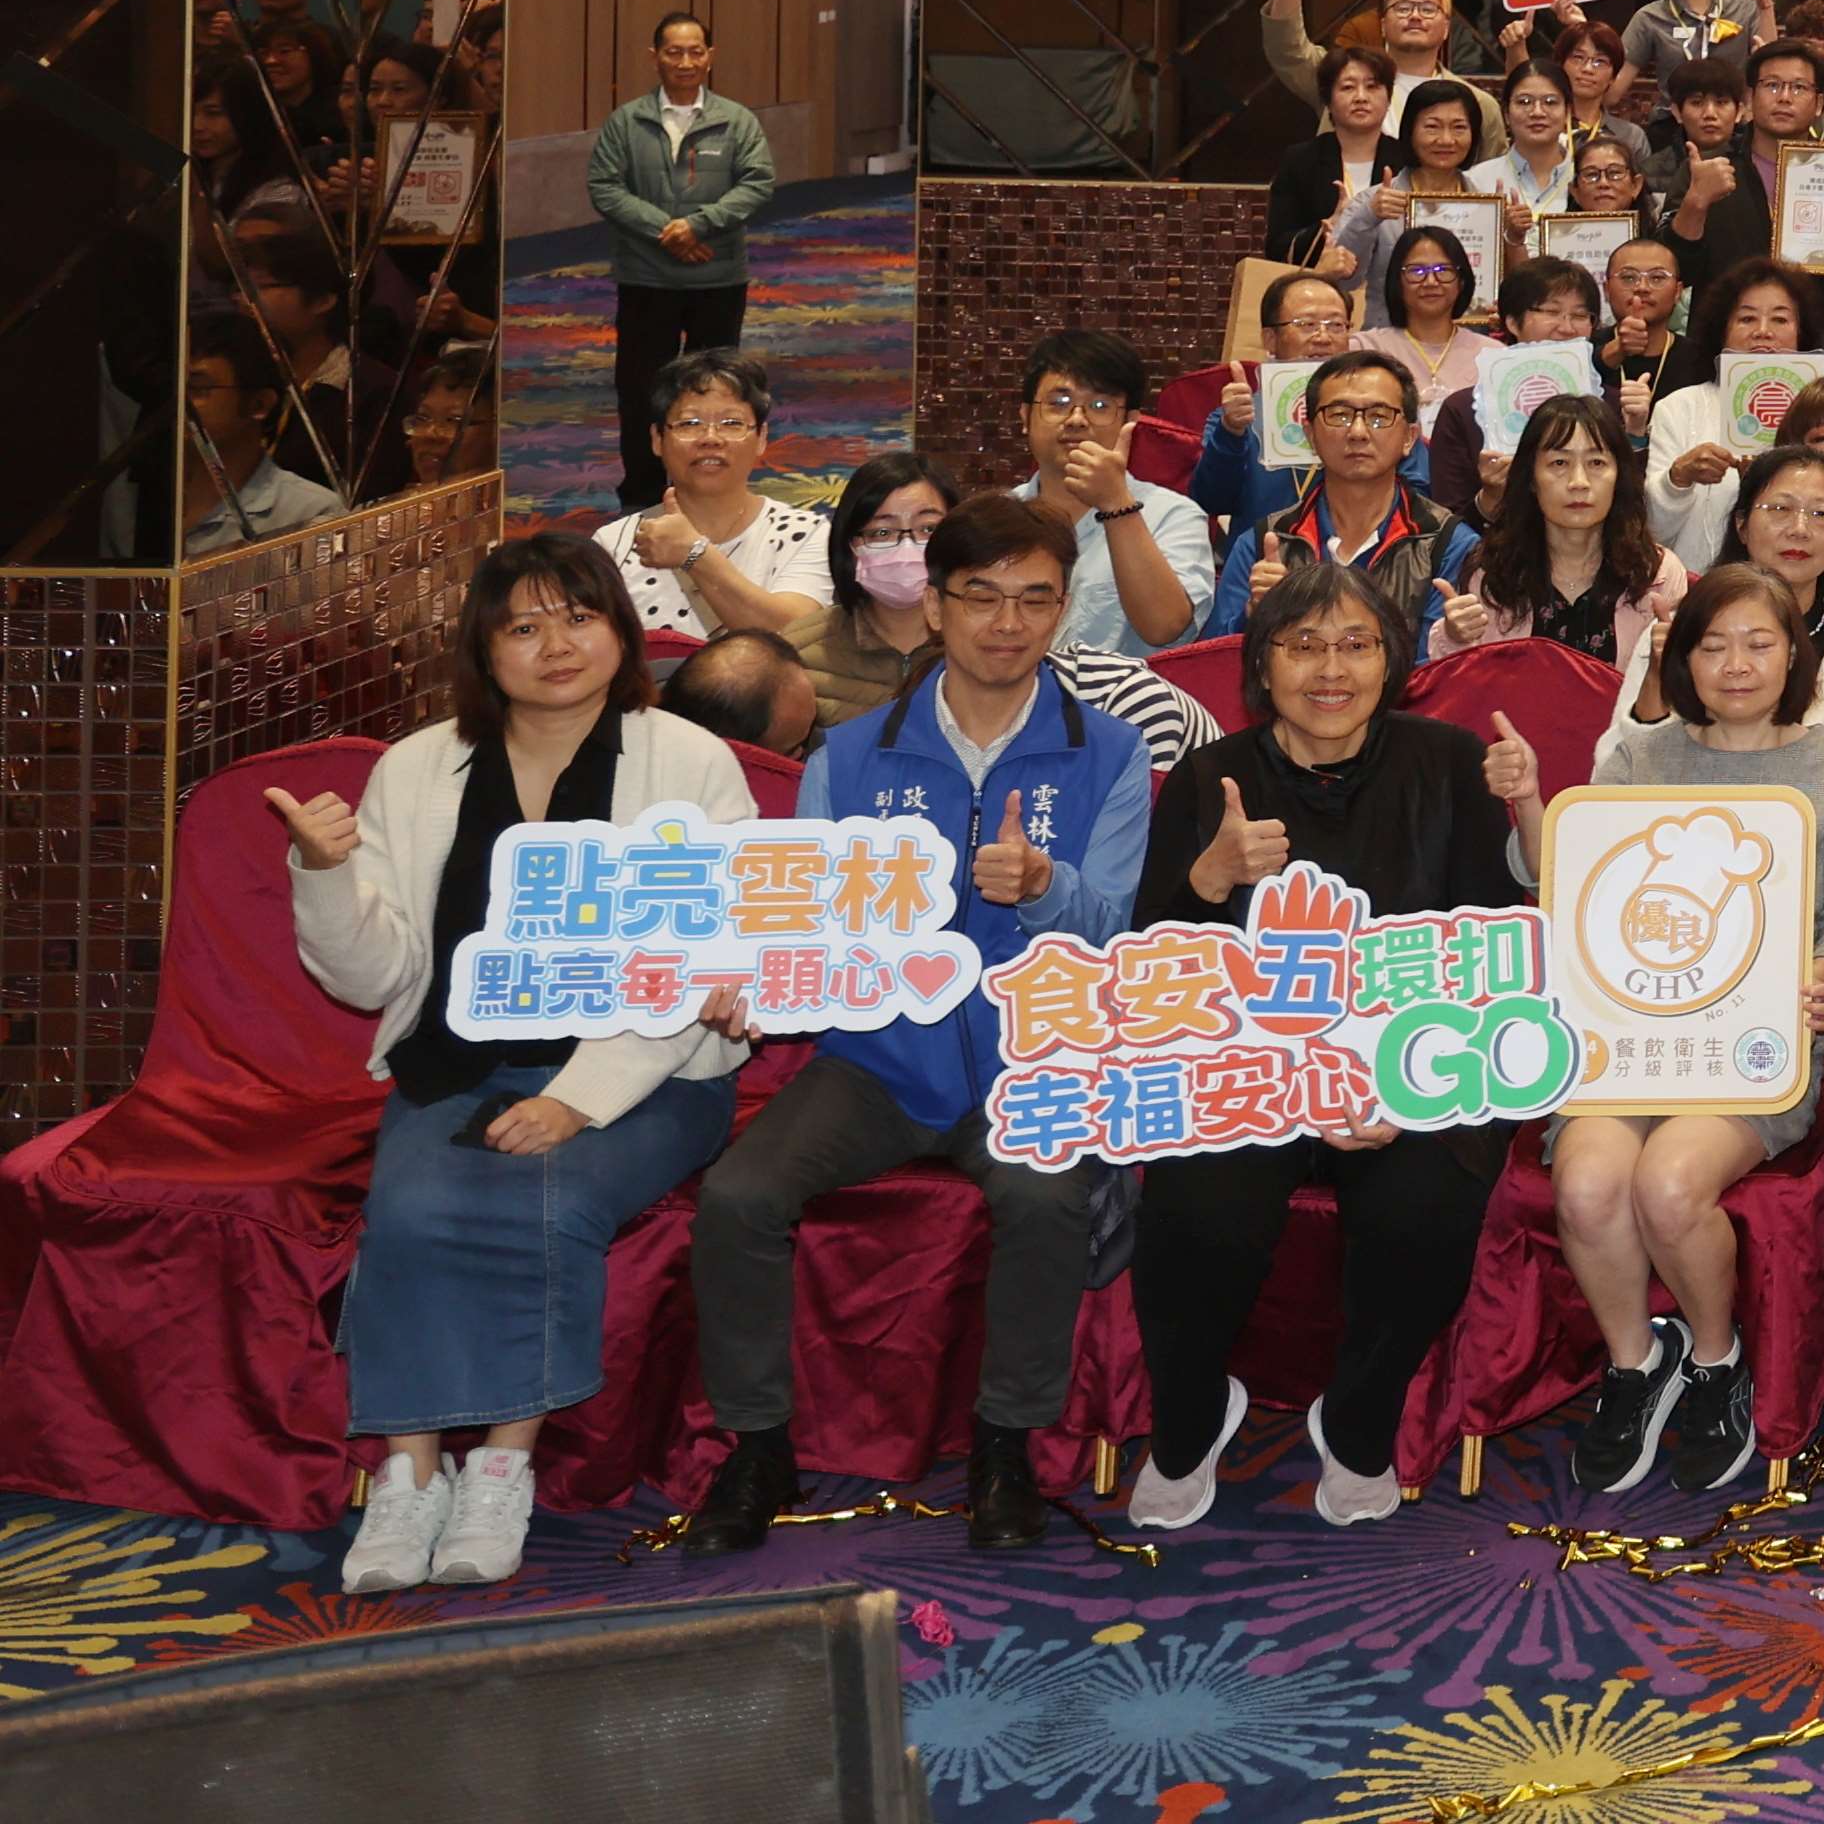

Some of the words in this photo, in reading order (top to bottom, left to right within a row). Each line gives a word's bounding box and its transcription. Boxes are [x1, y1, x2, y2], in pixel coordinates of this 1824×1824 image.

[507, 824, 937, 941] 點亮雲林
[1631, 898, 1705, 954] 優良
[473, 947, 897, 1017] 點亮每一顆心
[999, 918, 1529, 1056] 食安五環扣
[1625, 967, 1705, 1000] GHP
[1705, 1008, 1728, 1022] No.
[1732, 995, 1745, 1010] 11
[1614, 1060, 1724, 1077] 分級評核
[1615, 1037, 1724, 1058] 餐飲衛生
[1002, 1050, 1376, 1157] 幸福安心
[1376, 997, 1571, 1122] GO
